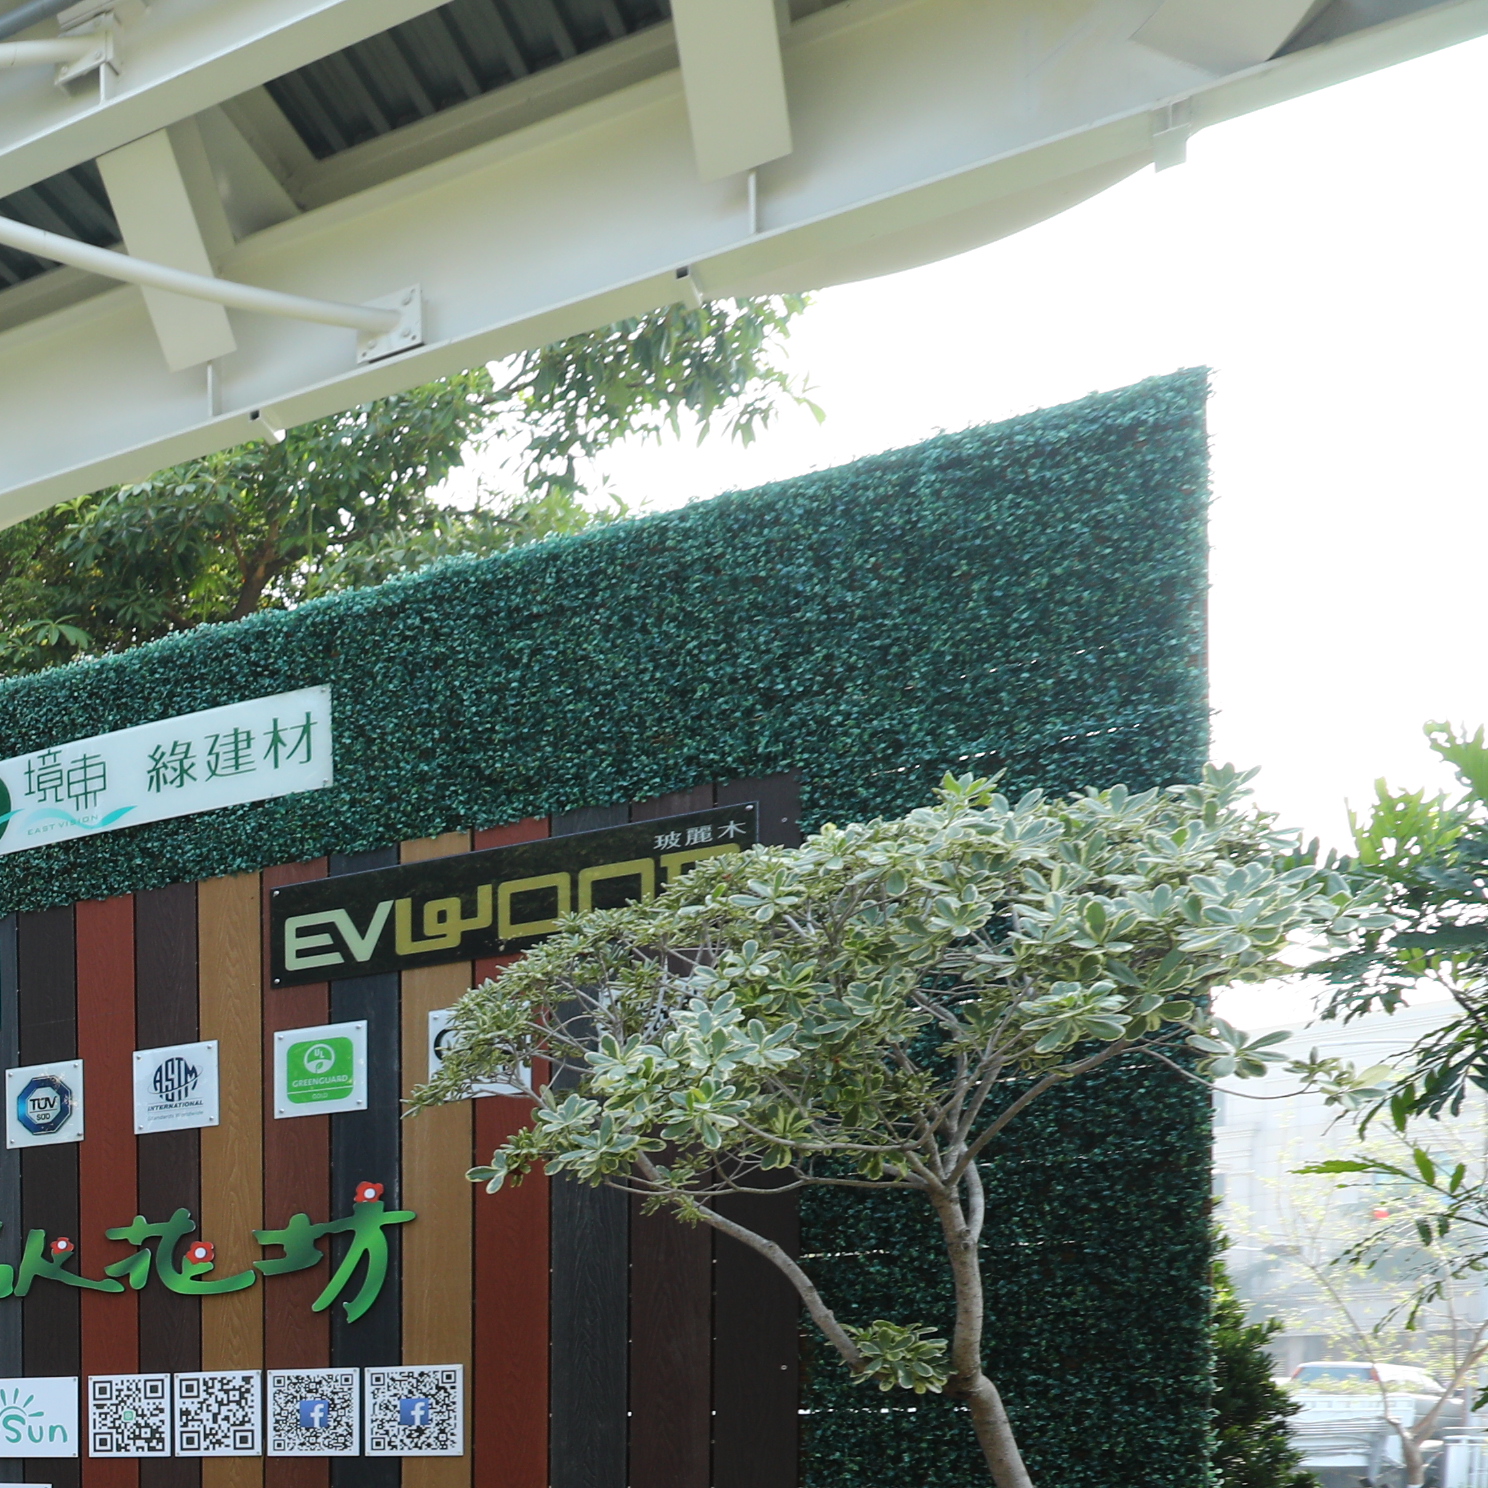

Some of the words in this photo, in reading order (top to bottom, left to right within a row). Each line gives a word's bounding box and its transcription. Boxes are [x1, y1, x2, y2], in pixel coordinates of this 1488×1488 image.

[147, 711, 318, 793] 綠建材
[27, 823, 56, 836] EAST
[58, 814, 99, 828] VISION
[653, 820, 747, 851] 玻麗木
[153, 1057, 199, 1102] ASTM
[292, 1074, 348, 1088] GREENGUARD
[147, 1099, 204, 1112] INTERNATIONAL
[2, 1413, 69, 1444] Sun
